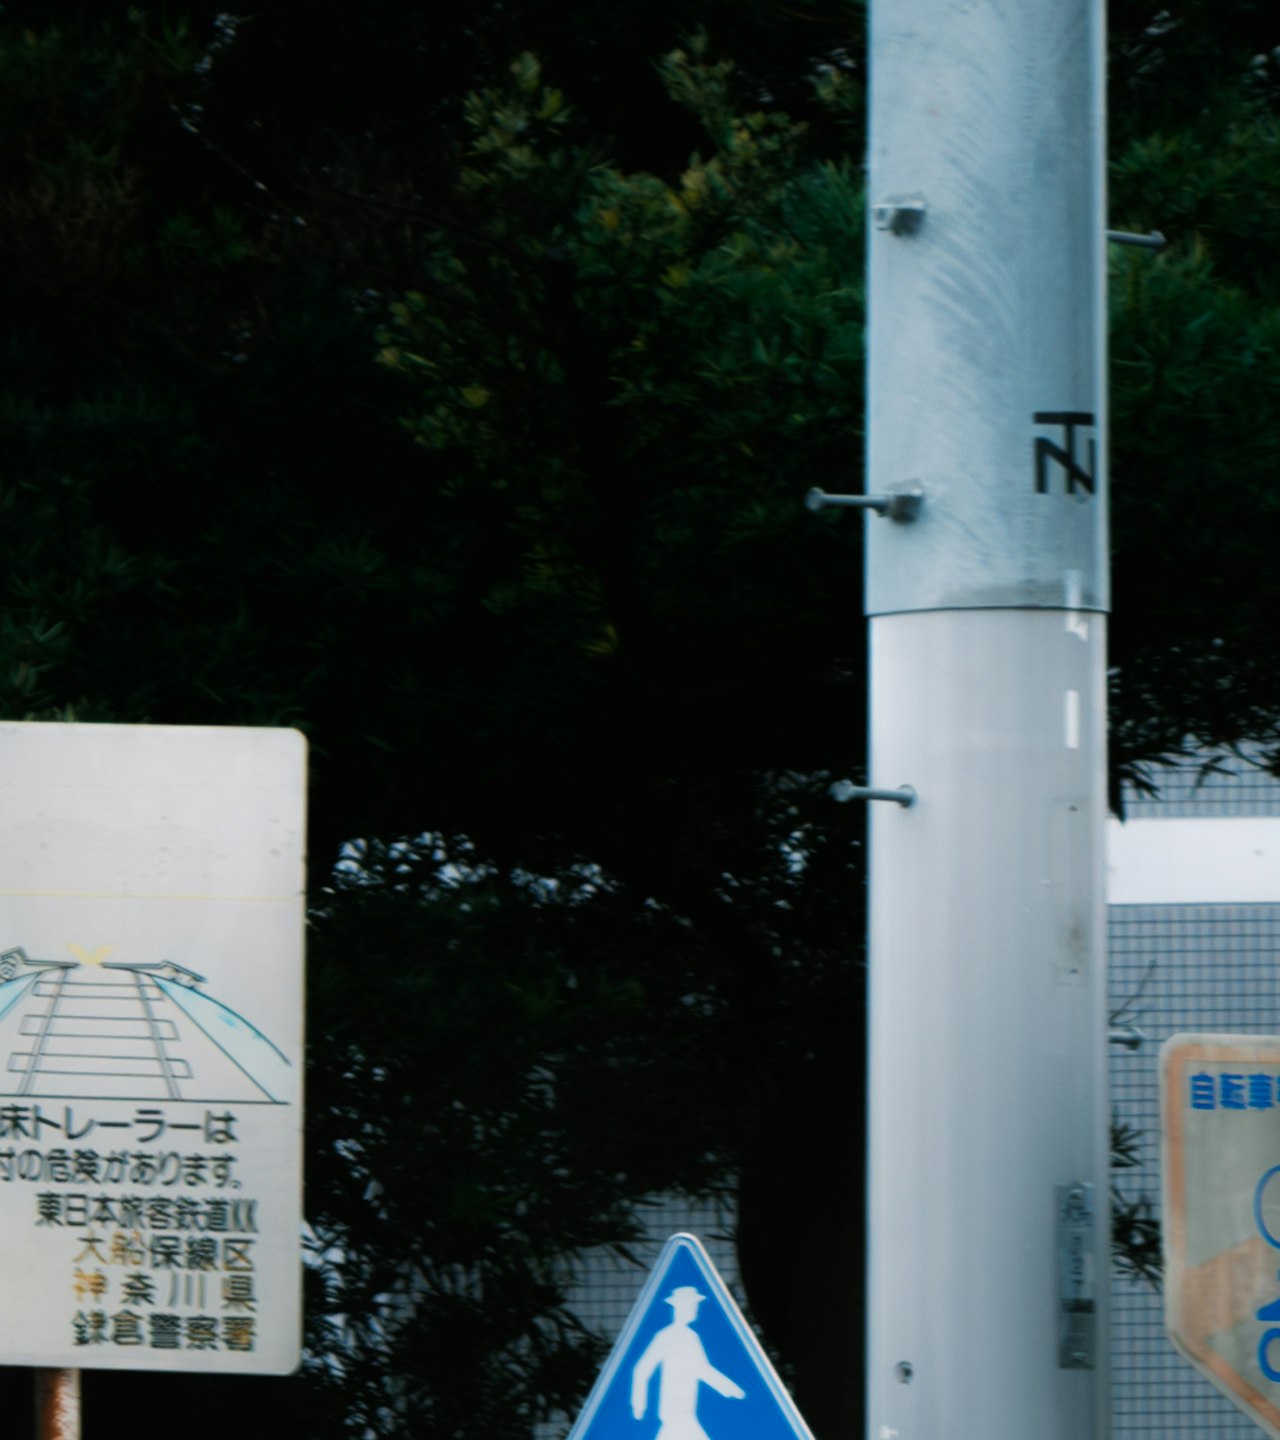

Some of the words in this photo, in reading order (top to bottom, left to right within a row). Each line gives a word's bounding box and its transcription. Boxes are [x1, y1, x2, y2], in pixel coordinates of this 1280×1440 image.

[73, 1231, 257, 1272] 大船保線区
[72, 1267, 257, 1312] 神奈川県
[71, 1309, 257, 1351] 鎌倉警察署
